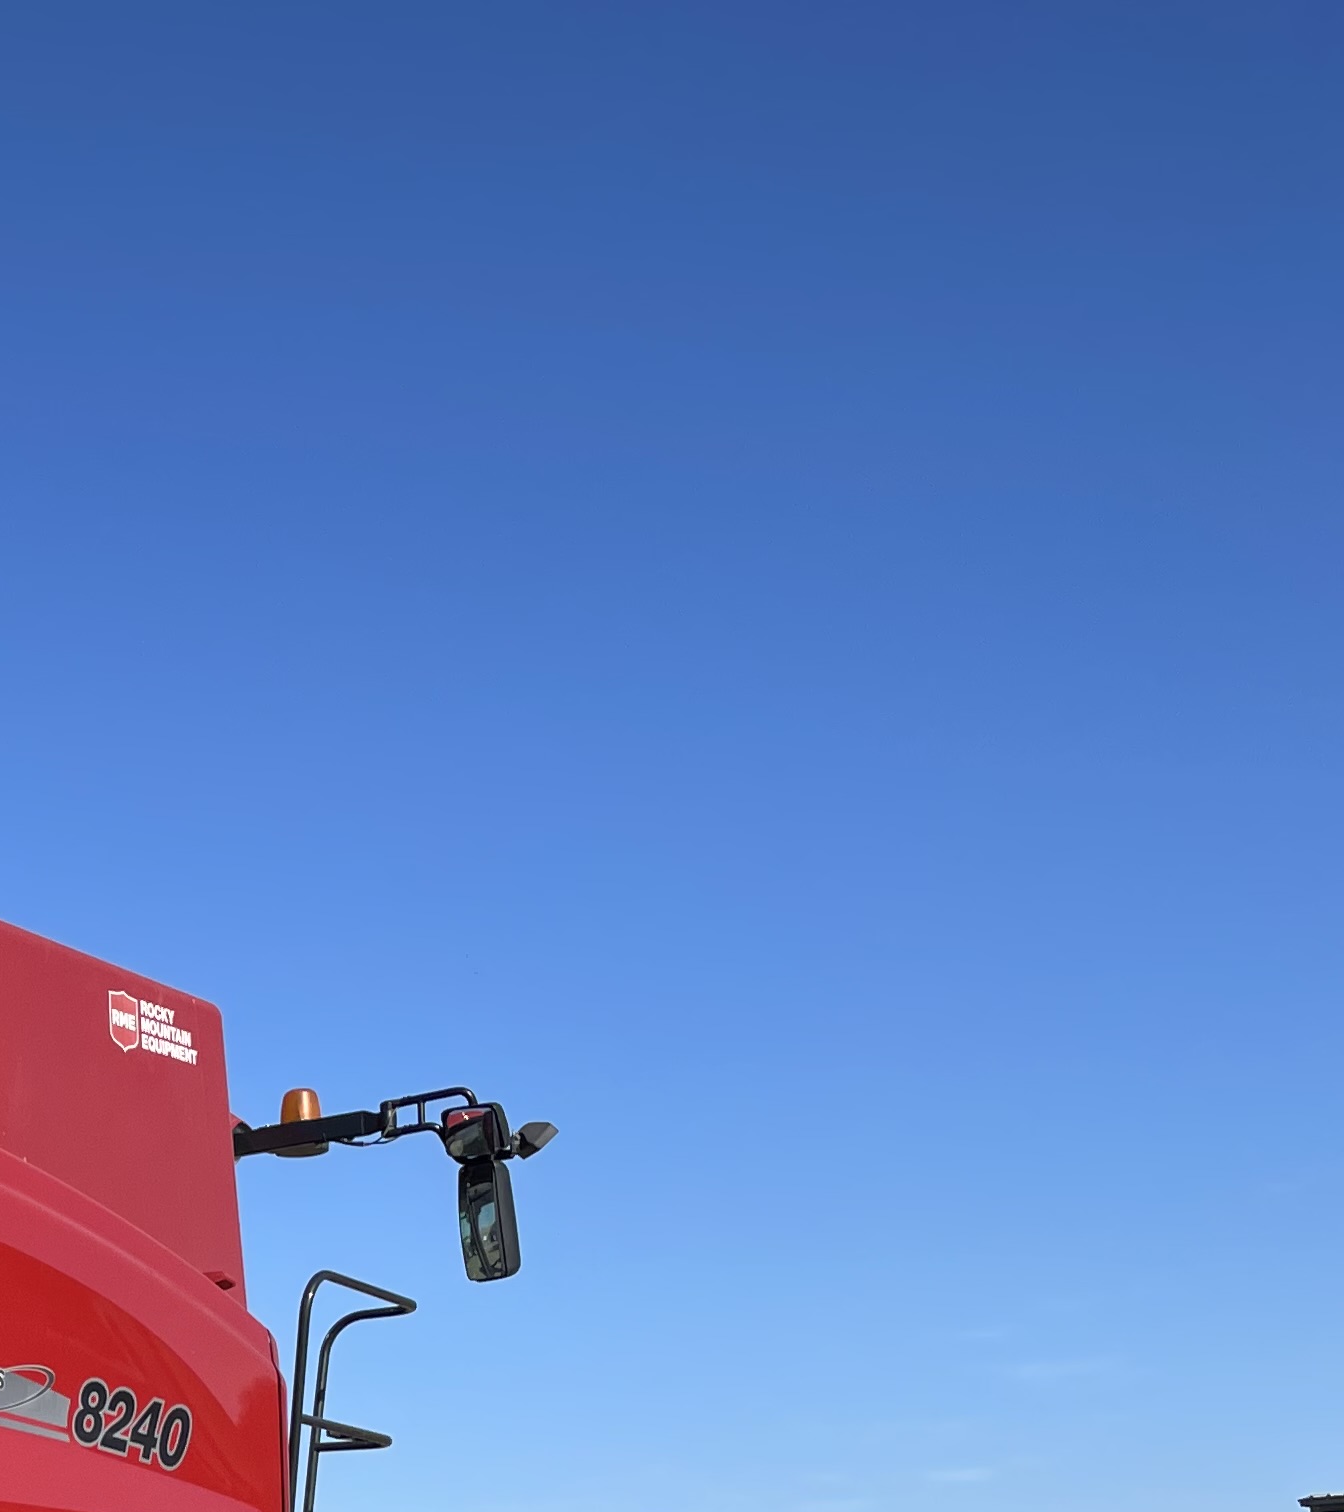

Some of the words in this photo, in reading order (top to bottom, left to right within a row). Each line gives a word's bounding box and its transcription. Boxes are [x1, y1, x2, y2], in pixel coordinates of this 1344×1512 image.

[112, 1008, 137, 1031] RME
[140, 1000, 175, 1025] ROCKY
[140, 1016, 192, 1047] MOUNTAIN
[141, 1033, 198, 1065] EQUIPMENT
[72, 1376, 192, 1472] 8240
